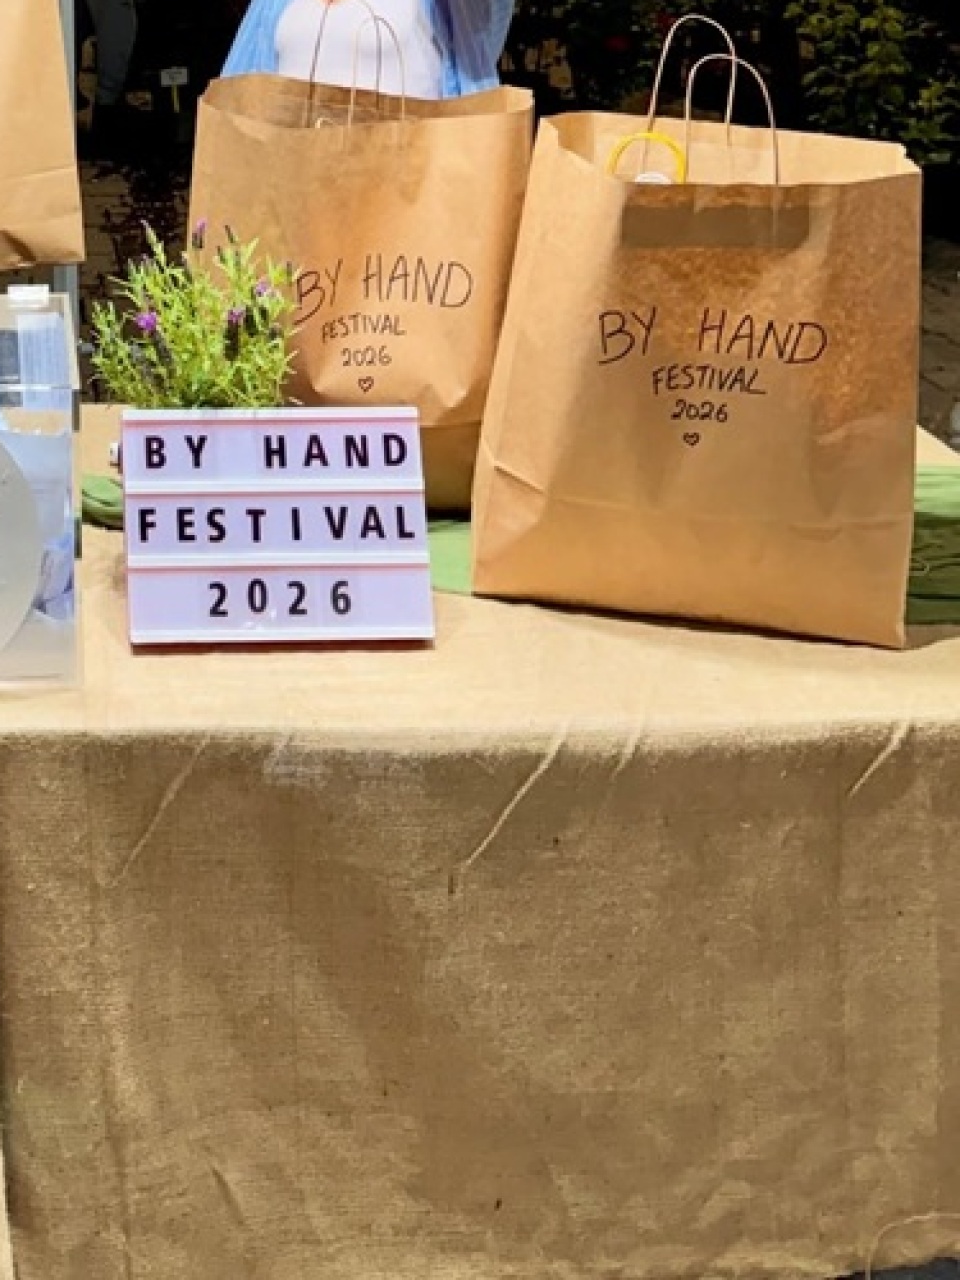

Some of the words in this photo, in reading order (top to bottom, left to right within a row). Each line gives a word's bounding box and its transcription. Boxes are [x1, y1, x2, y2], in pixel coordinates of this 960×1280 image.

[294, 258, 343, 325] BY
[363, 253, 474, 308] HAND
[322, 312, 407, 344] FESTIVAL
[598, 306, 658, 365] BY
[698, 307, 828, 364] HAND
[341, 345, 392, 367] 2026
[652, 363, 768, 395] FESTIVAL
[671, 399, 728, 423] 2026
[144, 434, 208, 469] BY
[263, 433, 408, 469] HAND
[137, 504, 416, 543] FESTIVAL
[208, 578, 352, 618] 2026
